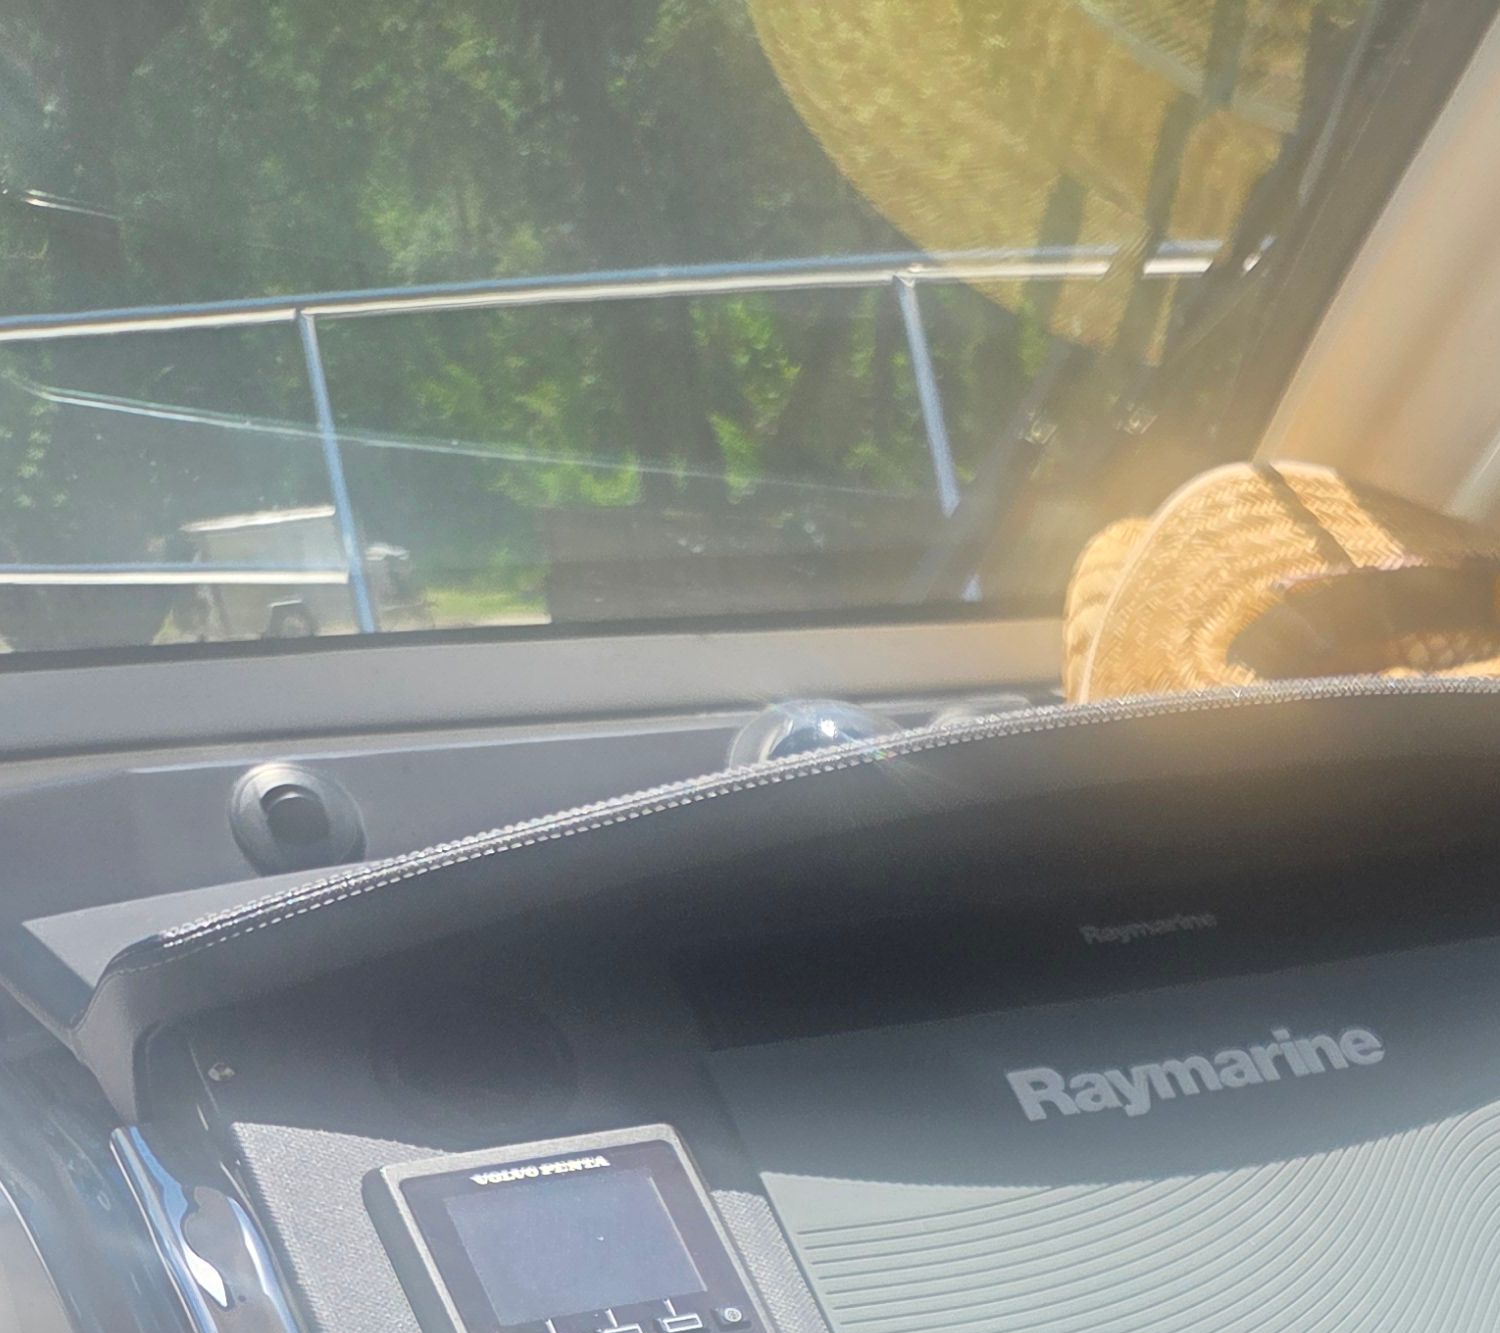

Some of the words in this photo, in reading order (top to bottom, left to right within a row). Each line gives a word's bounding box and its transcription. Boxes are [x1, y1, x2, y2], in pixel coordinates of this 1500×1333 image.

[1079, 913, 1217, 945] Raymarine
[1006, 1026, 1386, 1122] Raymarine
[469, 1166, 540, 1185] VOLVO
[539, 1155, 611, 1176] PENTA
